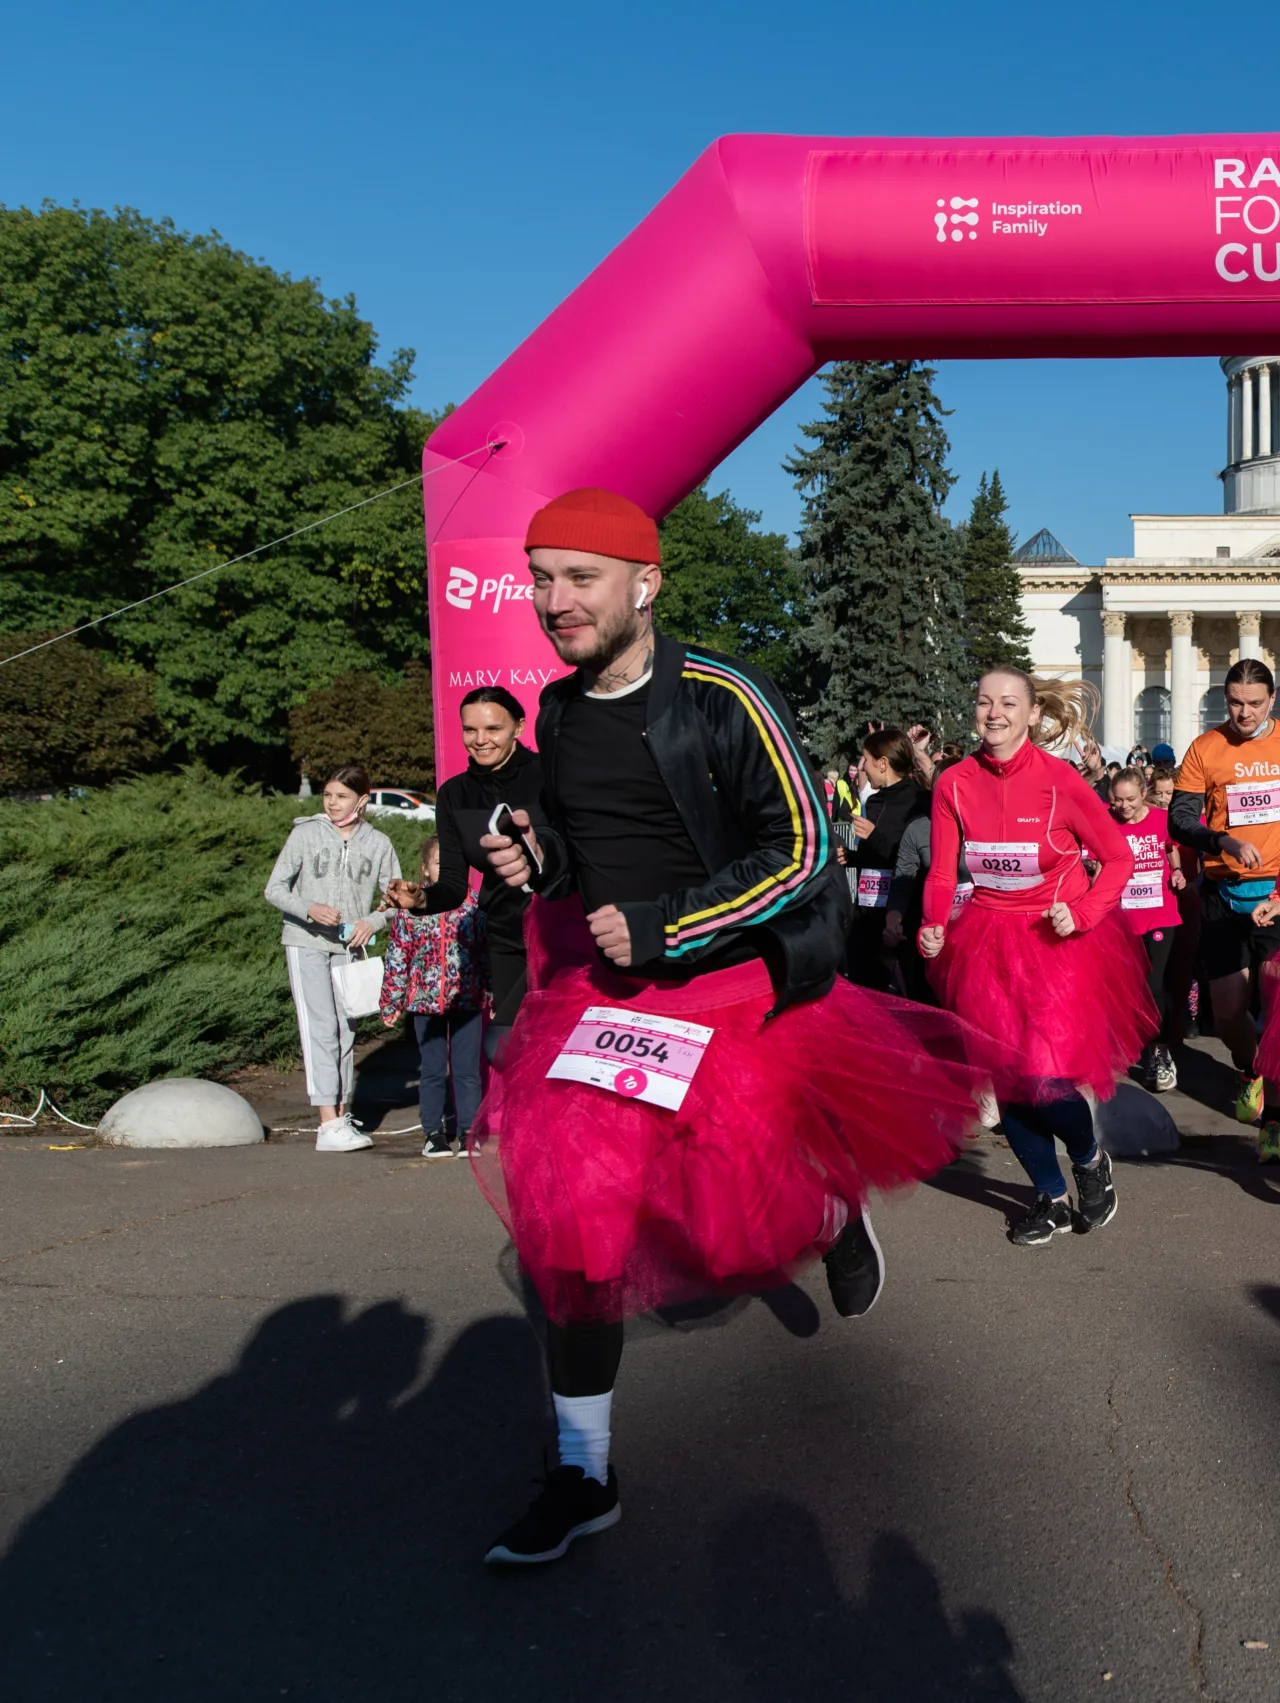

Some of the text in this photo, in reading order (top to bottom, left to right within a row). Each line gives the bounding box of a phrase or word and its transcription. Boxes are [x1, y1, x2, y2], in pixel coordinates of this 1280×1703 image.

[992, 201, 1082, 218] Inspiration
[992, 219, 1048, 237] Family
[480, 574, 534, 613] Pfize
[449, 669, 501, 687] MARY
[1240, 794, 1271, 807] 0350
[1131, 834, 1157, 845] RACE
[982, 858, 1022, 872] 0282
[1130, 887, 1153, 896] 0091
[595, 1030, 669, 1064] 0054
